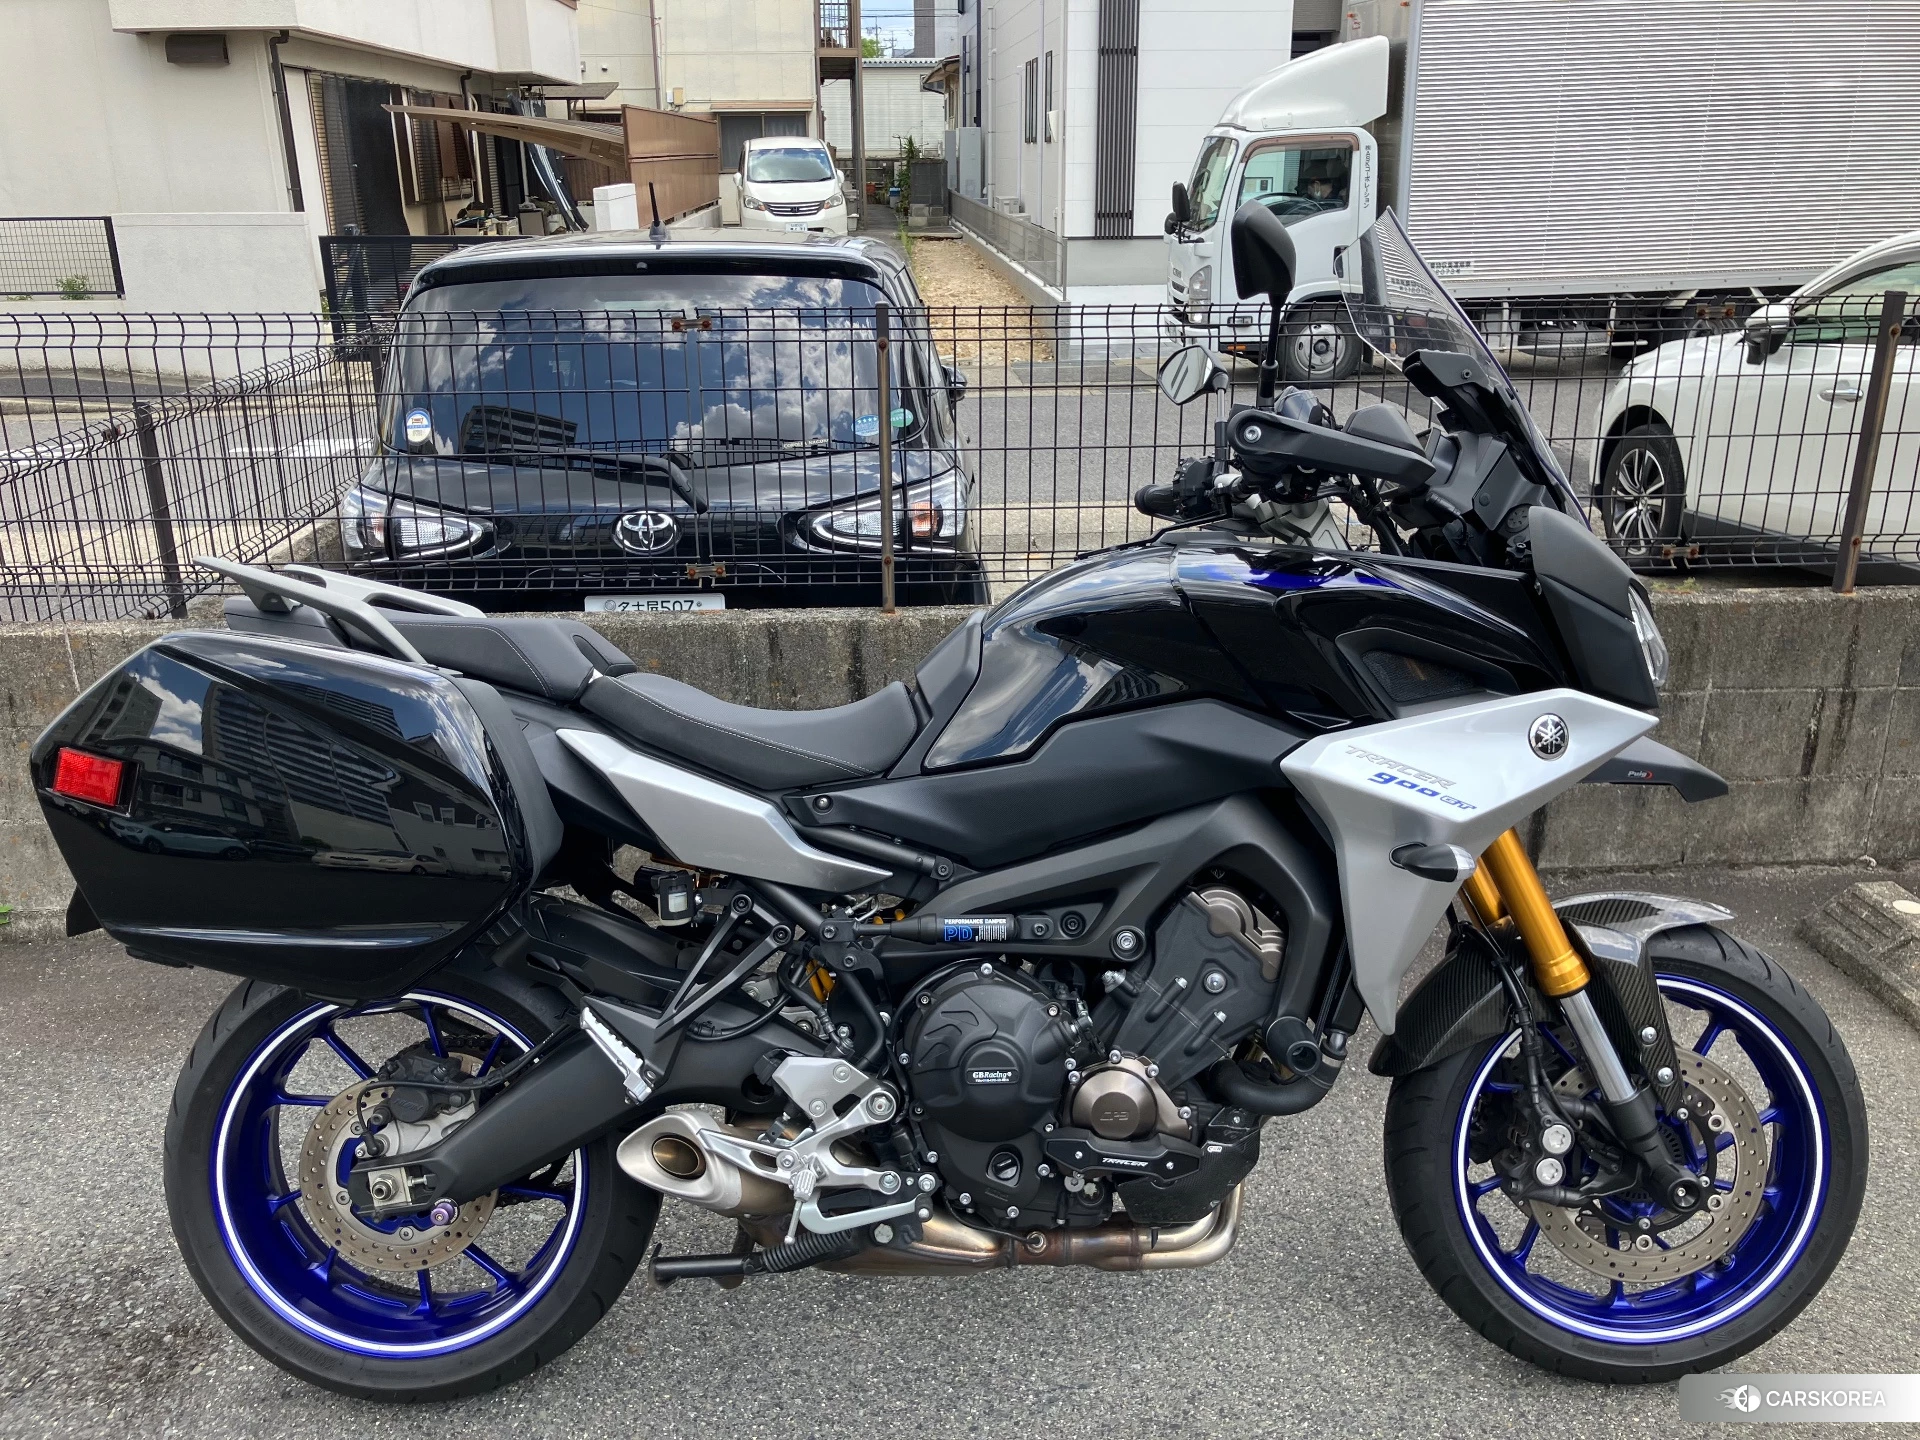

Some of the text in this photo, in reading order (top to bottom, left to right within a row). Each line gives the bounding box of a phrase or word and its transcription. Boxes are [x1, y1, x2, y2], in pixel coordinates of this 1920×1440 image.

[1345, 745, 1457, 790] TRACER
[1367, 772, 1477, 810] 900 GT
[944, 925, 973, 942] PD
[1101, 1157, 1149, 1168] TRACER
